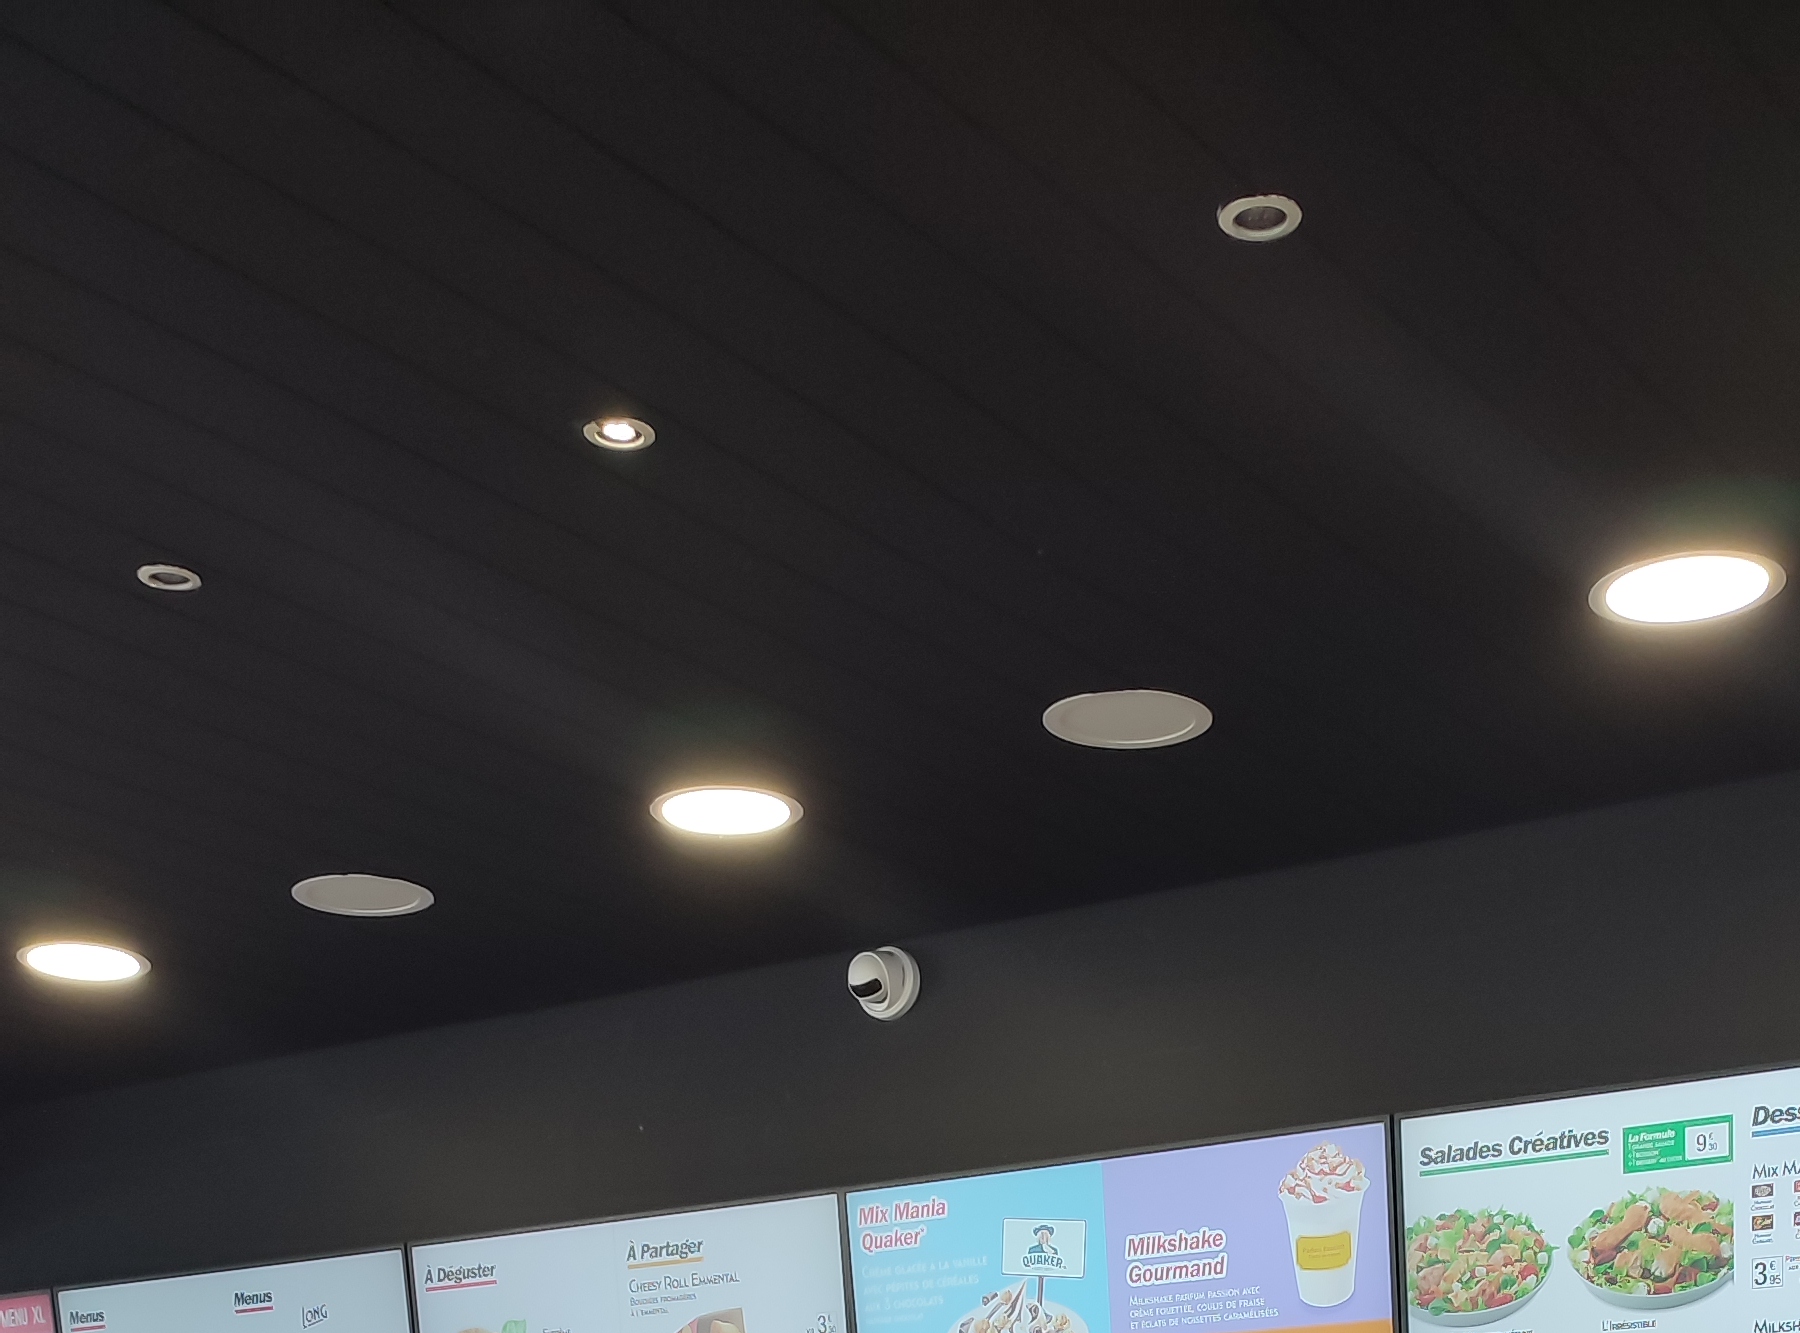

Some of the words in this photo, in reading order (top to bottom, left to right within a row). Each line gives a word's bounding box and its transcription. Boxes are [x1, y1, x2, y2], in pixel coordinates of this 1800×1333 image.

[1628, 1133, 1640, 1143] La
[1640, 1128, 1676, 1142] Formule
[1419, 1141, 1503, 1166] Salades
[1508, 1129, 1610, 1156] Créatives
[1782, 1160, 1800, 1176] M
[860, 1206, 889, 1226] Mix
[894, 1199, 946, 1221] Mania
[627, 1240, 637, 1262] À
[641, 1239, 704, 1260] Partager
[1127, 1229, 1224, 1258] Milkshake
[938, 1260, 950, 1270] LA
[1022, 1254, 1064, 1269] QUAKER
[1129, 1255, 1226, 1284] Gourmand
[424, 1265, 434, 1285] À
[437, 1263, 497, 1284] Déguster
[234, 1291, 273, 1307] Menus
[1226, 1300, 1237, 1309] DE
[0, 1306, 28, 1329] MENU
[32, 1305, 46, 1324] XL
[69, 1311, 105, 1325] Menus
[1168, 1317, 1179, 1326] DE
